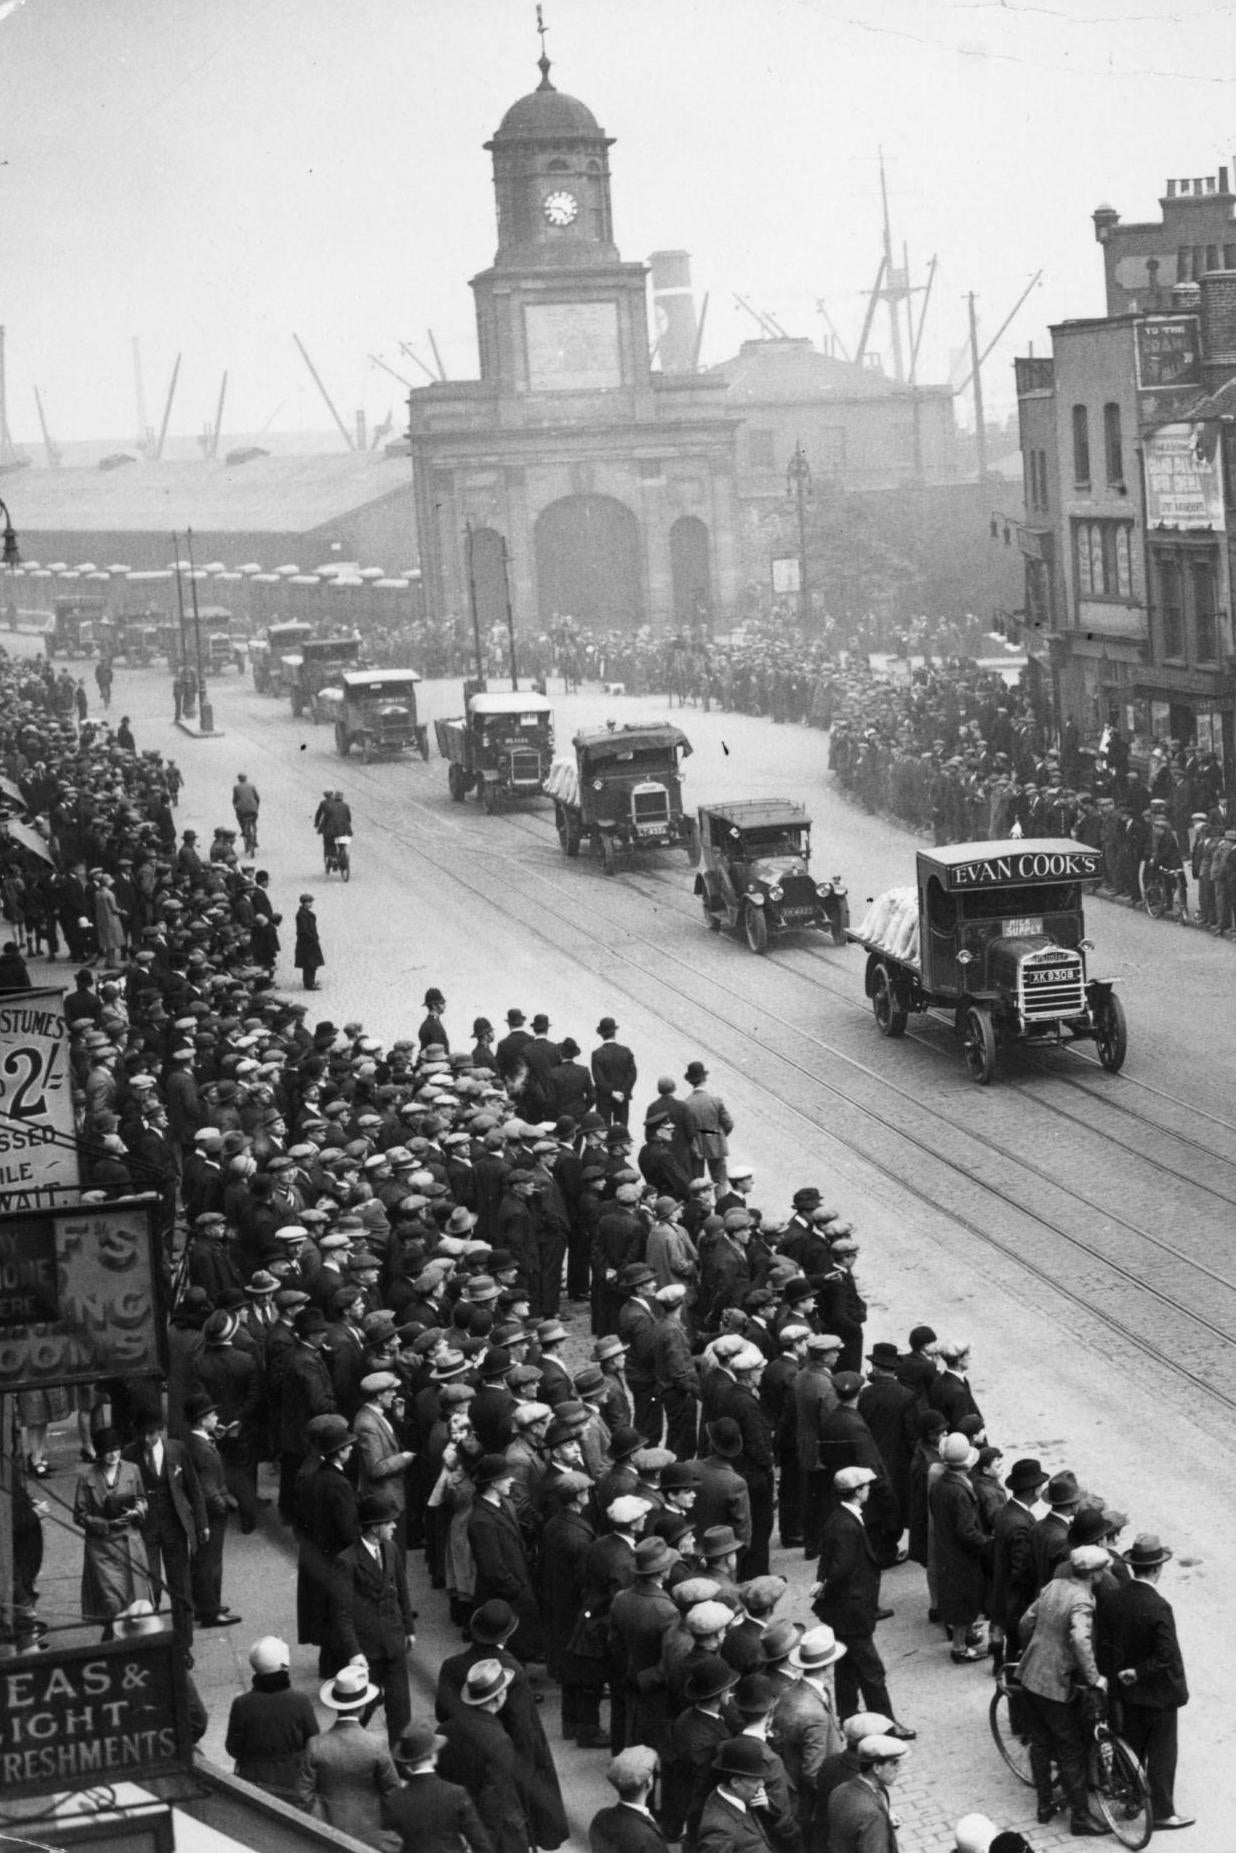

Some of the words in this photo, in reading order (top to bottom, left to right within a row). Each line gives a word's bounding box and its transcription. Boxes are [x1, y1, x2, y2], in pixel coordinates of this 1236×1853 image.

[956, 857, 1012, 883] EVAN
[1018, 854, 1096, 878] COOK'S
[1006, 923, 1041, 937] SUPPLY
[1008, 917, 1031, 927] MILK
[7, 1661, 111, 1708] EAS
[121, 1663, 150, 1690] &
